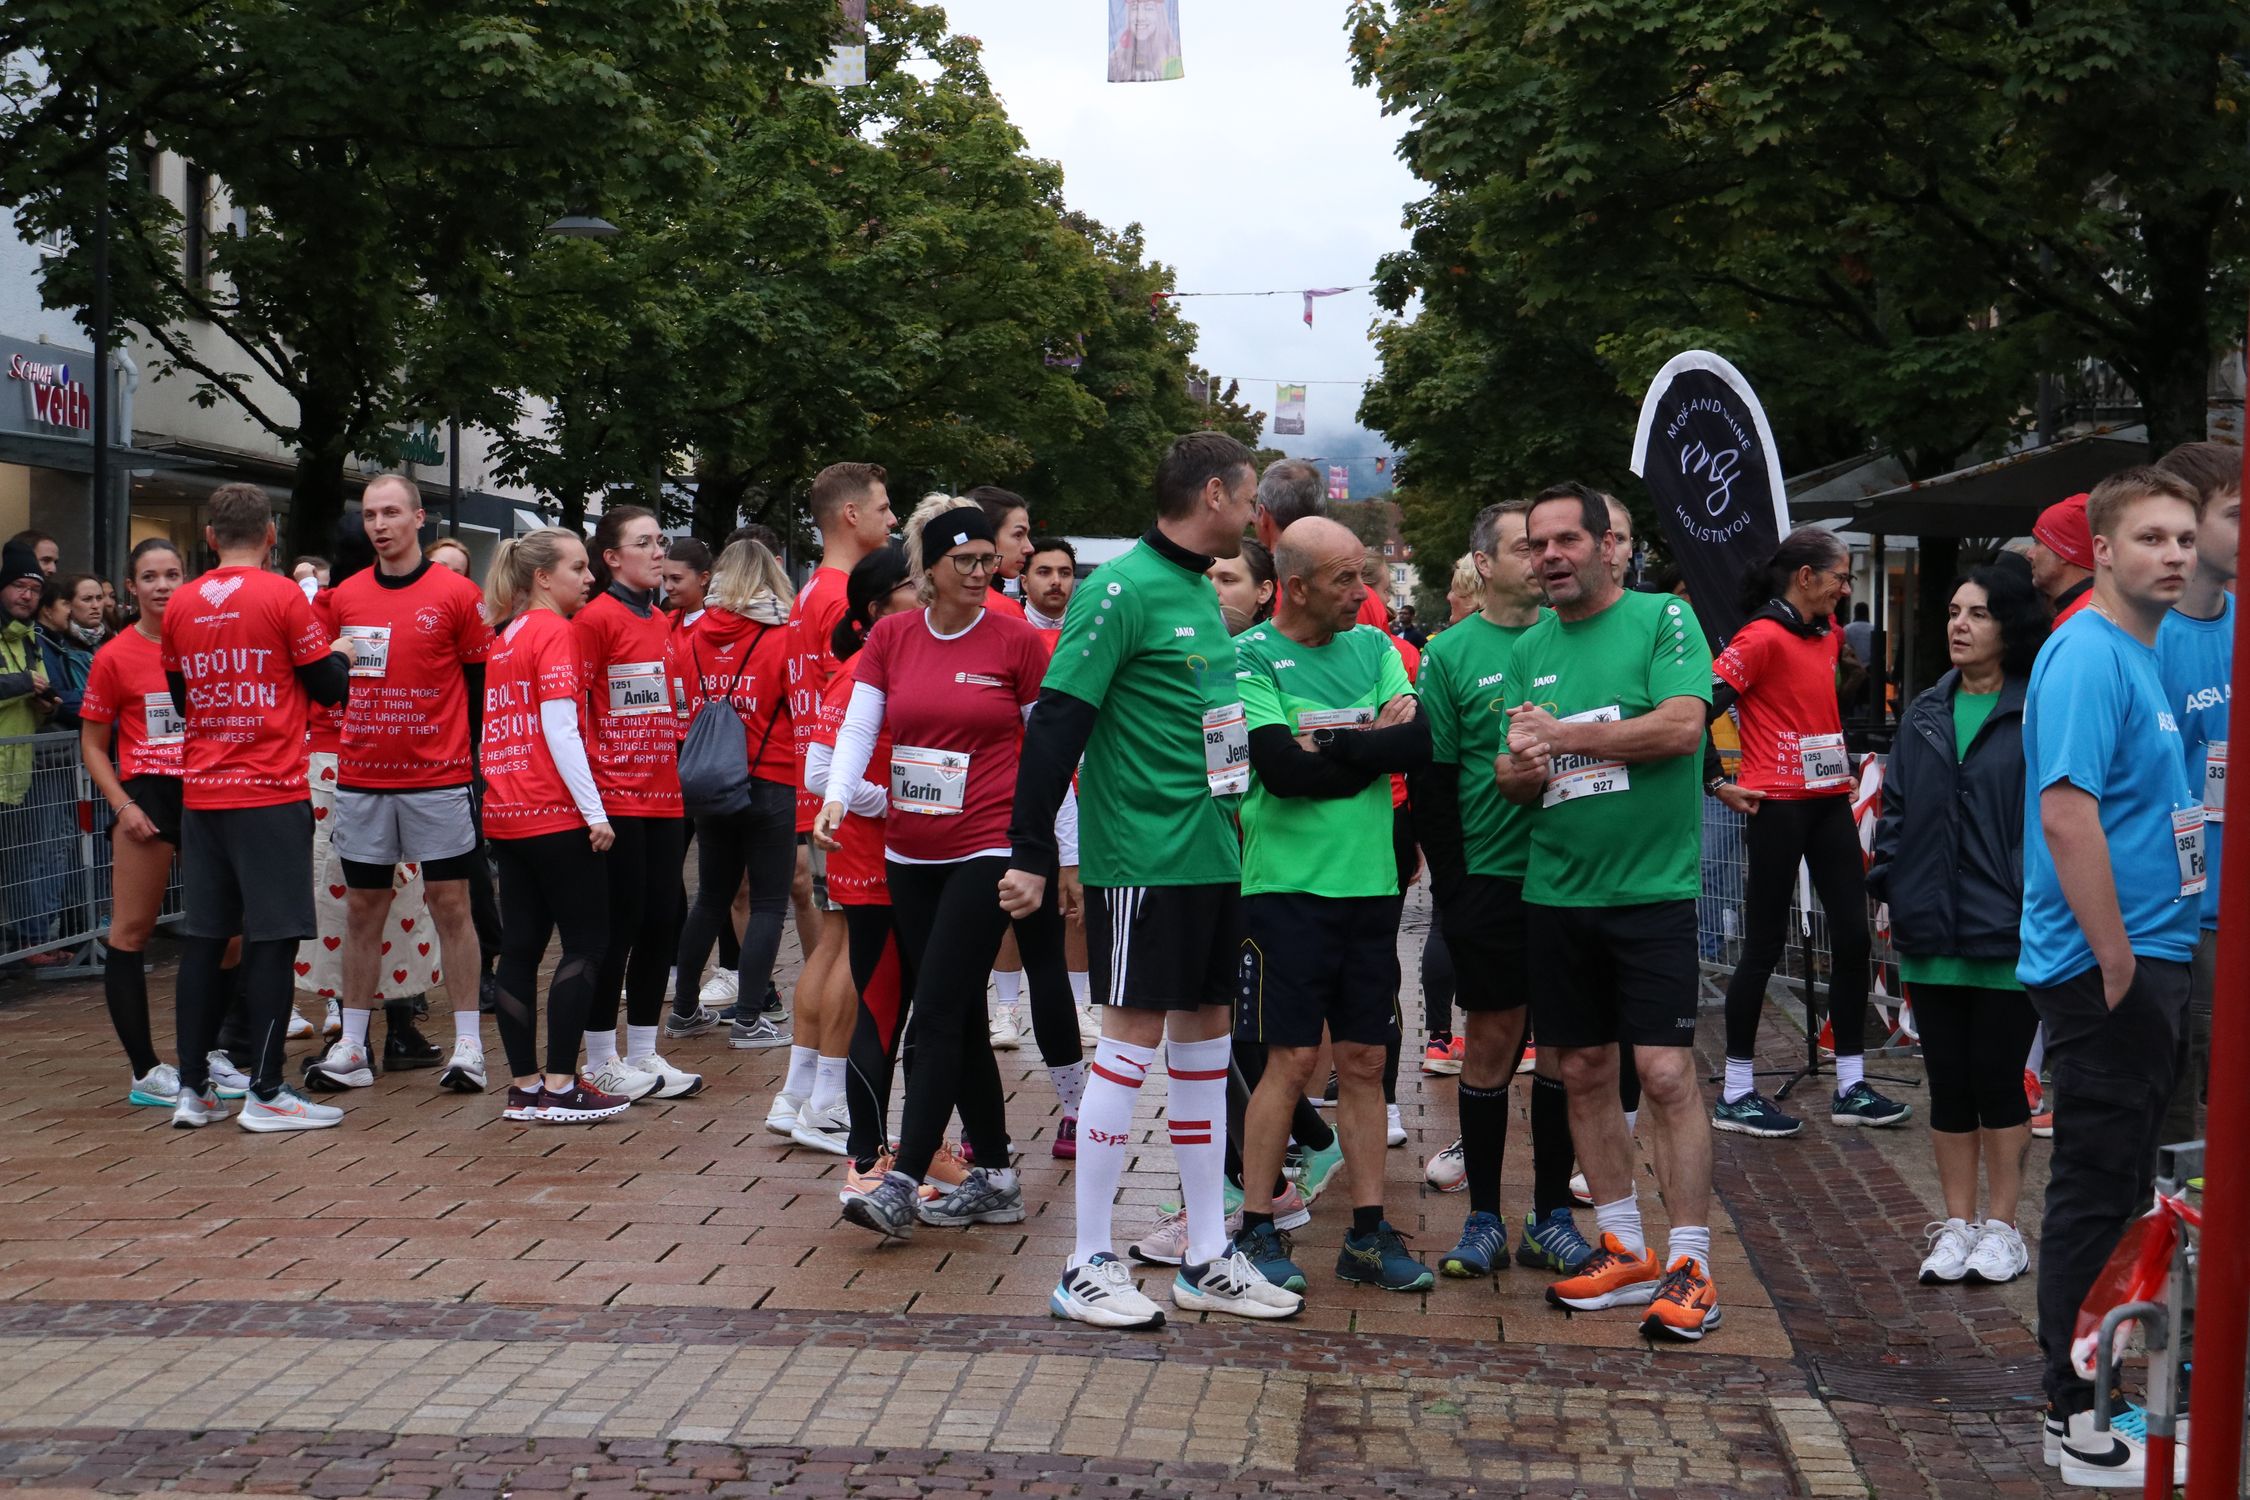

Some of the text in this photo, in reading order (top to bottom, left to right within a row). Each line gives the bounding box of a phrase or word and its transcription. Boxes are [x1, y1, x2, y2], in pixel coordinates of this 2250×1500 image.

[1690, 398, 1722, 413] AND
[1175, 627, 1196, 637] JAKO
[181, 648, 272, 679] ABOUT
[611, 681, 631, 689] 1251
[1478, 673, 1503, 688] JAKO
[1533, 674, 1557, 688] JAKO
[373, 688, 407, 697] THING
[410, 688, 440, 697] MORE
[624, 689, 660, 705] Anika
[384, 700, 413, 710] THAN
[148, 709, 169, 718] 1255
[328, 709, 344, 717] THE
[375, 713, 426, 722] WARRIOR
[599, 718, 620, 728] THE
[622, 715, 650, 727] ONLY
[388, 725, 402, 735] OF
[408, 724, 439, 735] THEM
[599, 729, 656, 739] CONFIDENT
[1207, 732, 1224, 744] 926
[1778, 732, 1799, 740] THE
[600, 742, 607, 751] A
[612, 742, 649, 752] SINGLE
[598, 755, 609, 763] IS
[614, 755, 629, 764] AN
[1804, 753, 1822, 762] 1253
[893, 766, 906, 776] 423
[1777, 766, 1788, 774] IS
[1815, 761, 1844, 777] Conni
[902, 780, 942, 802] Karin
[1593, 780, 1613, 792] 927
[2178, 836, 2195, 851] 352
